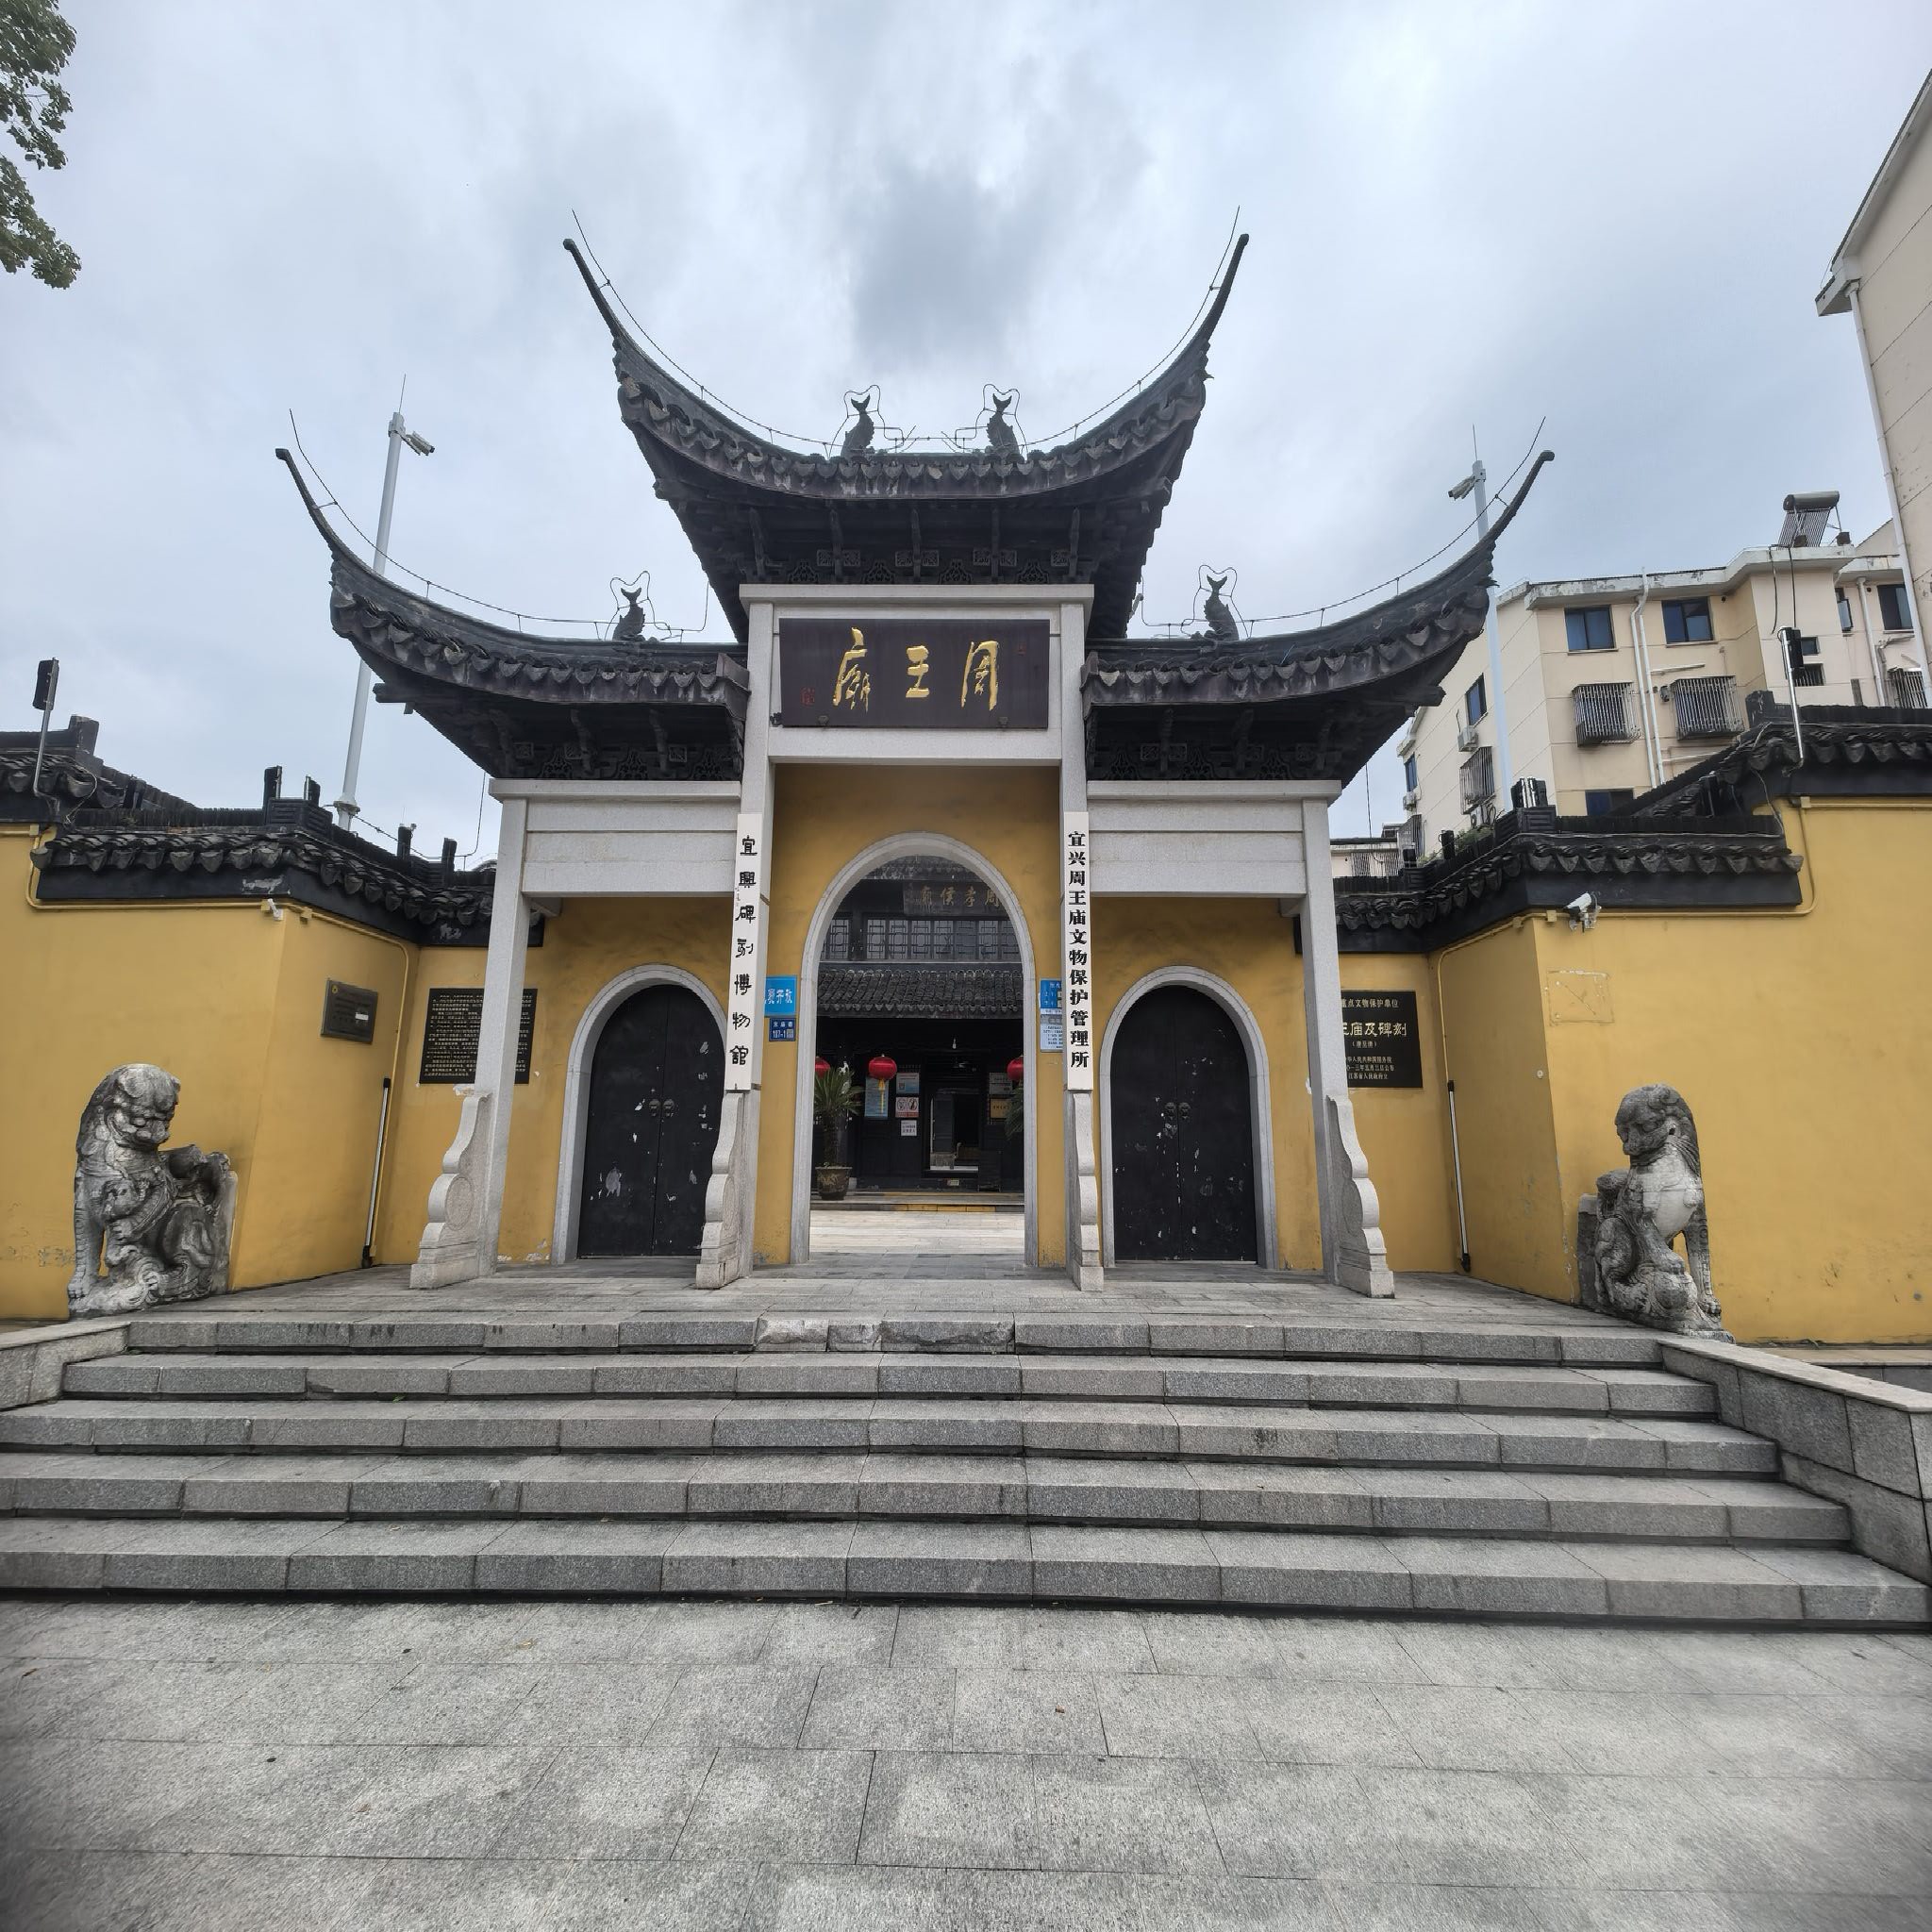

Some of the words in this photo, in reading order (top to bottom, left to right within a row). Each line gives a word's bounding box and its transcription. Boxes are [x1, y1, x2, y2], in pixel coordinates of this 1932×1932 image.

[1067, 830, 1090, 1069] 宜兴周王庙文物保护管理所
